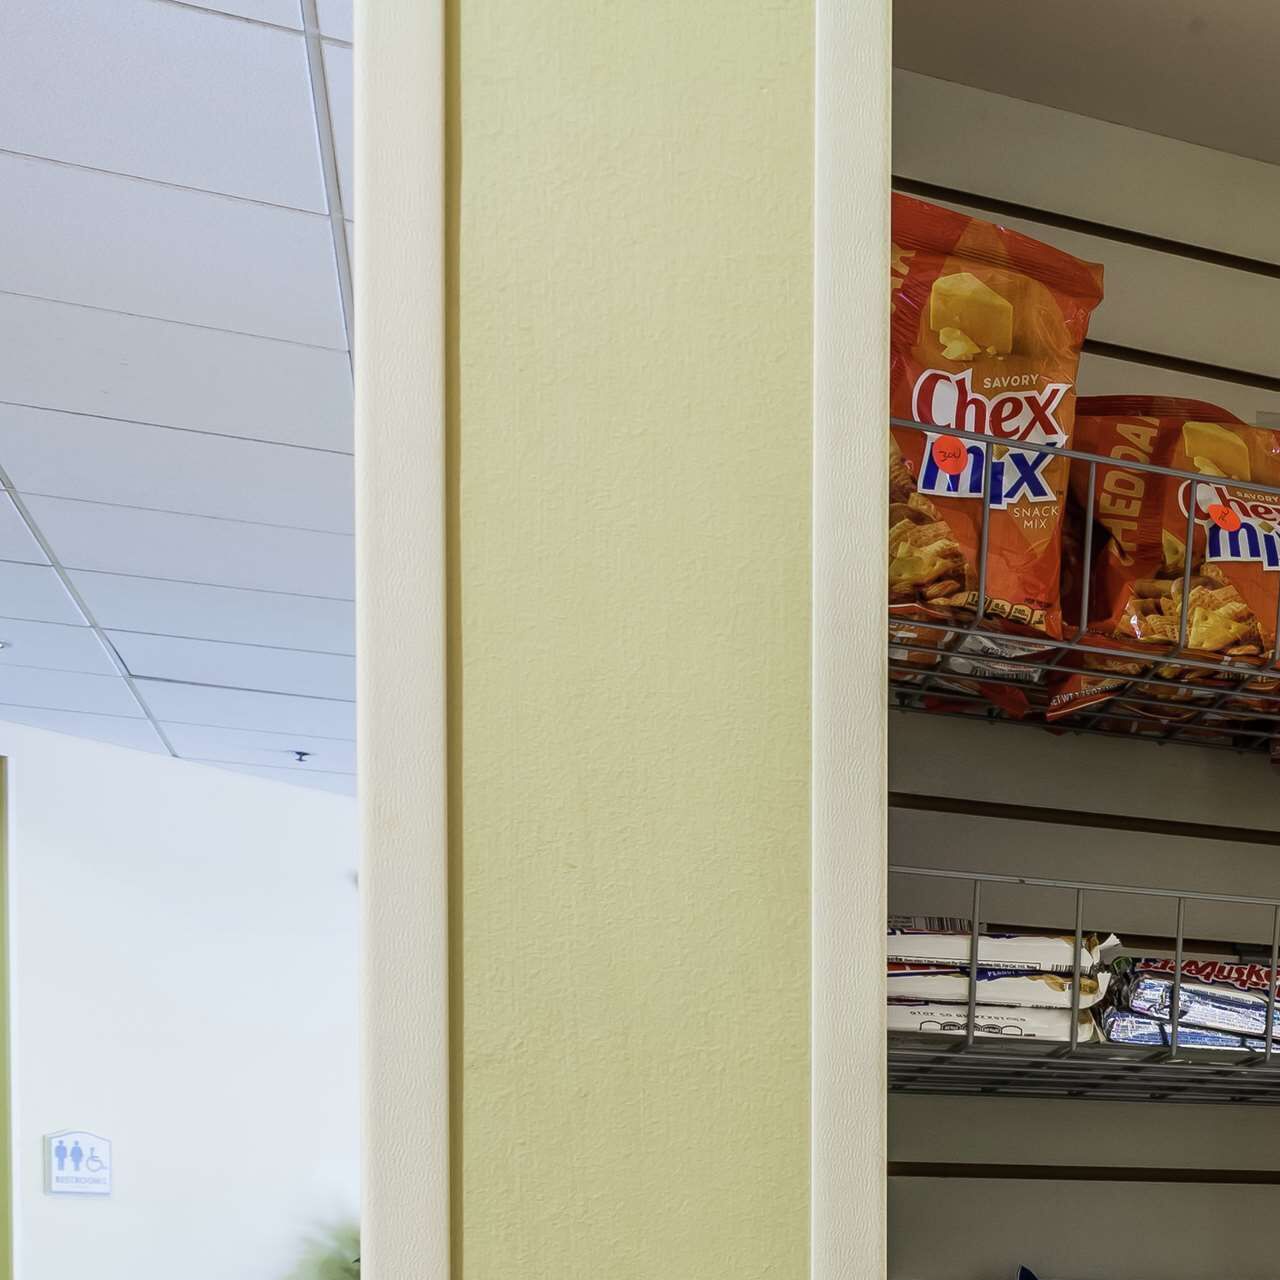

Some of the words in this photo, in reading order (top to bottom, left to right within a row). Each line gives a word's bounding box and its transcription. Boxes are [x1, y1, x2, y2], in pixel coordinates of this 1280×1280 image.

[984, 374, 1039, 389] SAVORY
[914, 370, 1070, 443] Chex
[919, 440, 1057, 507] mix
[1236, 491, 1279, 503] SAVORY
[1013, 506, 1059, 518] SNACK
[1023, 518, 1047, 529] MIX
